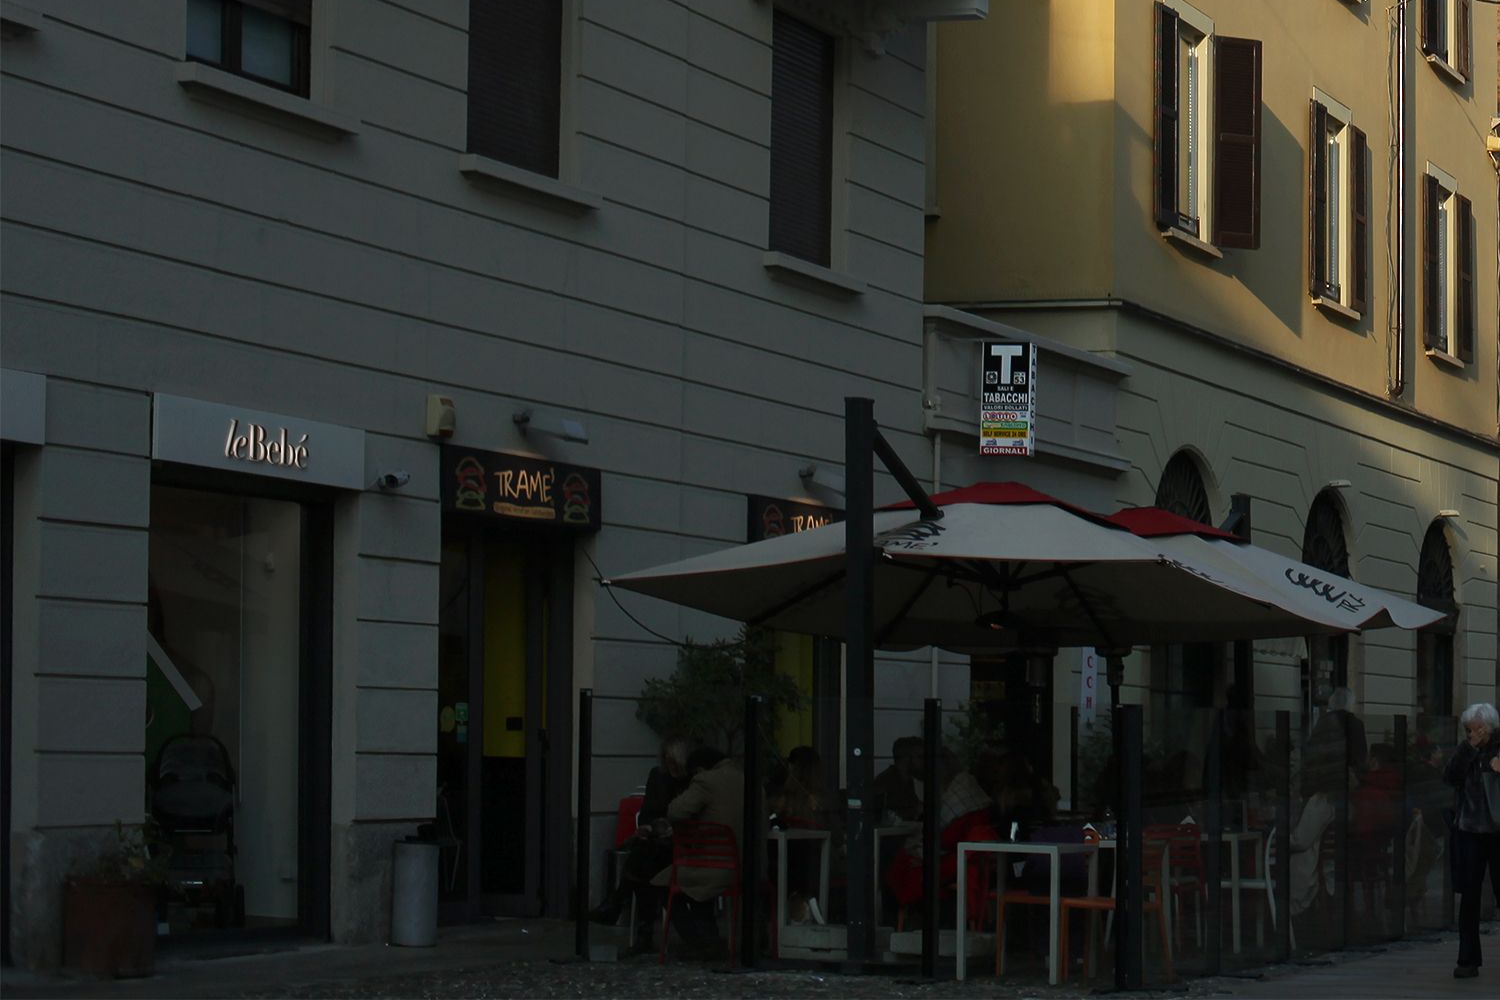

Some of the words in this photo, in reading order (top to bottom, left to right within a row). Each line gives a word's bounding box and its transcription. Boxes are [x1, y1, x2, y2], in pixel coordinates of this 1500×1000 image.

[991, 344, 1023, 385] T
[1014, 376, 1025, 384] 53
[984, 392, 1028, 403] TABACCHI
[983, 447, 1026, 455] GIORNALI
